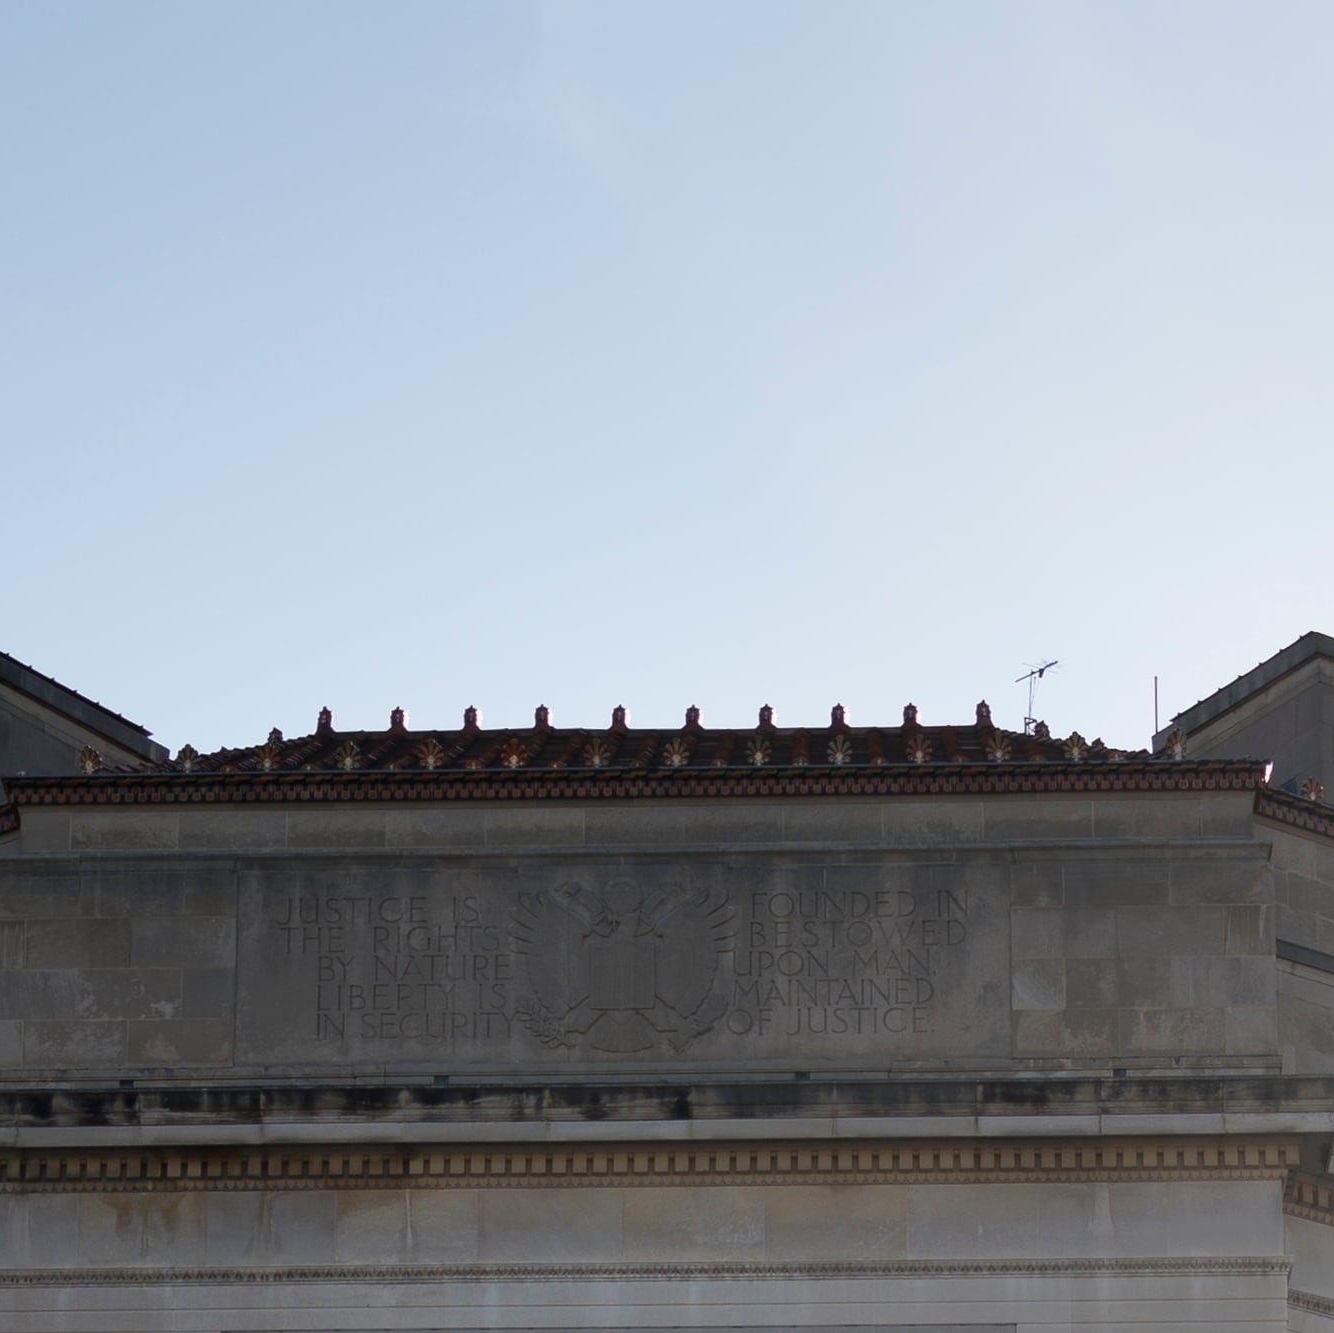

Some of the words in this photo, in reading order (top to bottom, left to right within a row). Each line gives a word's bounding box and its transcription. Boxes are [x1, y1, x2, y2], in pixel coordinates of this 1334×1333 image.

[276, 896, 429, 925] JUSTICE
[452, 896, 480, 923] IS
[751, 891, 918, 918] FOUNDED
[937, 889, 969, 918] IN
[279, 926, 345, 954] THE
[373, 925, 500, 953] RIGHTS
[750, 919, 967, 948] BESTOWED
[317, 956, 356, 982] BY
[374, 954, 514, 981] NATURE
[733, 950, 830, 977] UPON
[317, 984, 456, 1011] LIBERTY
[478, 983, 508, 1010] IS
[733, 978, 935, 1007] MAINTAINED
[316, 1012, 346, 1040] IN
[360, 1012, 517, 1040] SECURITY
[727, 1008, 773, 1036] OF
